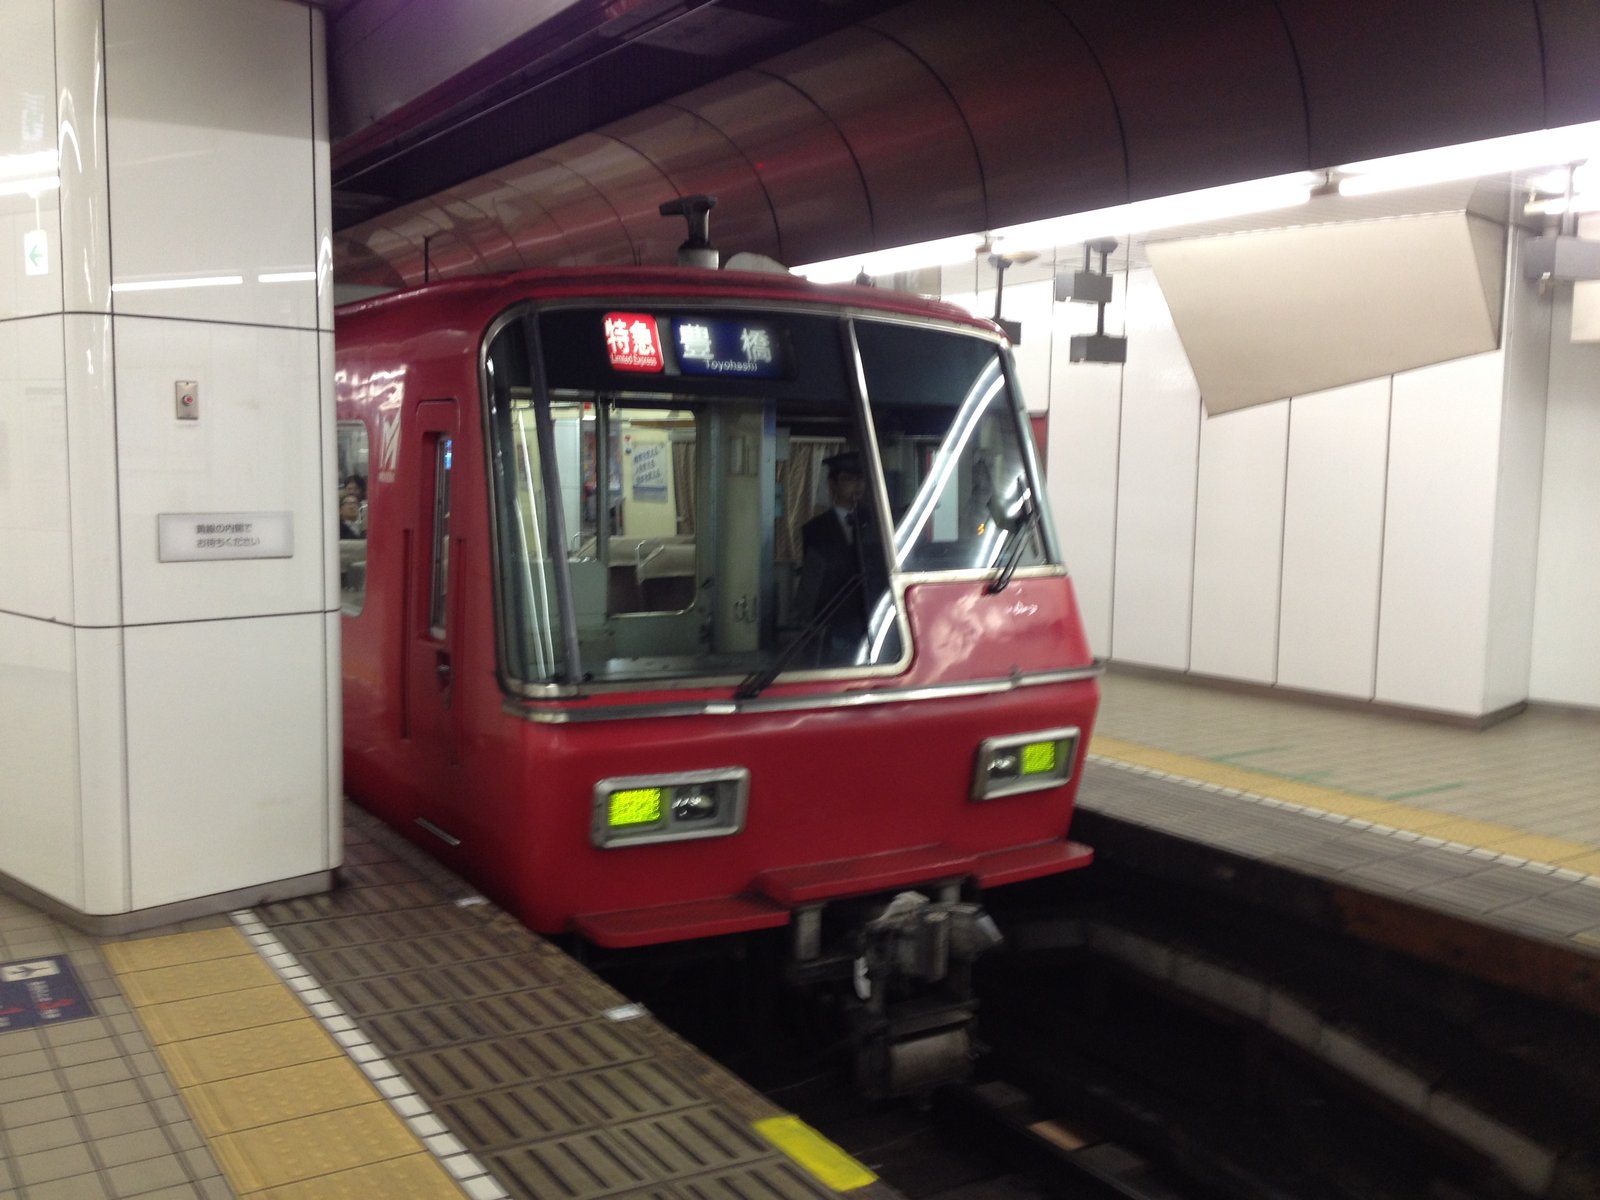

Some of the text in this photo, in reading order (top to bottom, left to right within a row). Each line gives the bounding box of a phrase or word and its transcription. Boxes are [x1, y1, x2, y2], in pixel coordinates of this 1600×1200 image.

[605, 317, 656, 355] 特急
[679, 323, 772, 363] 豊橋
[610, 353, 657, 367] Limited Express
[705, 358, 758, 372] Toyohashi
[196, 536, 261, 548] お待ちください
